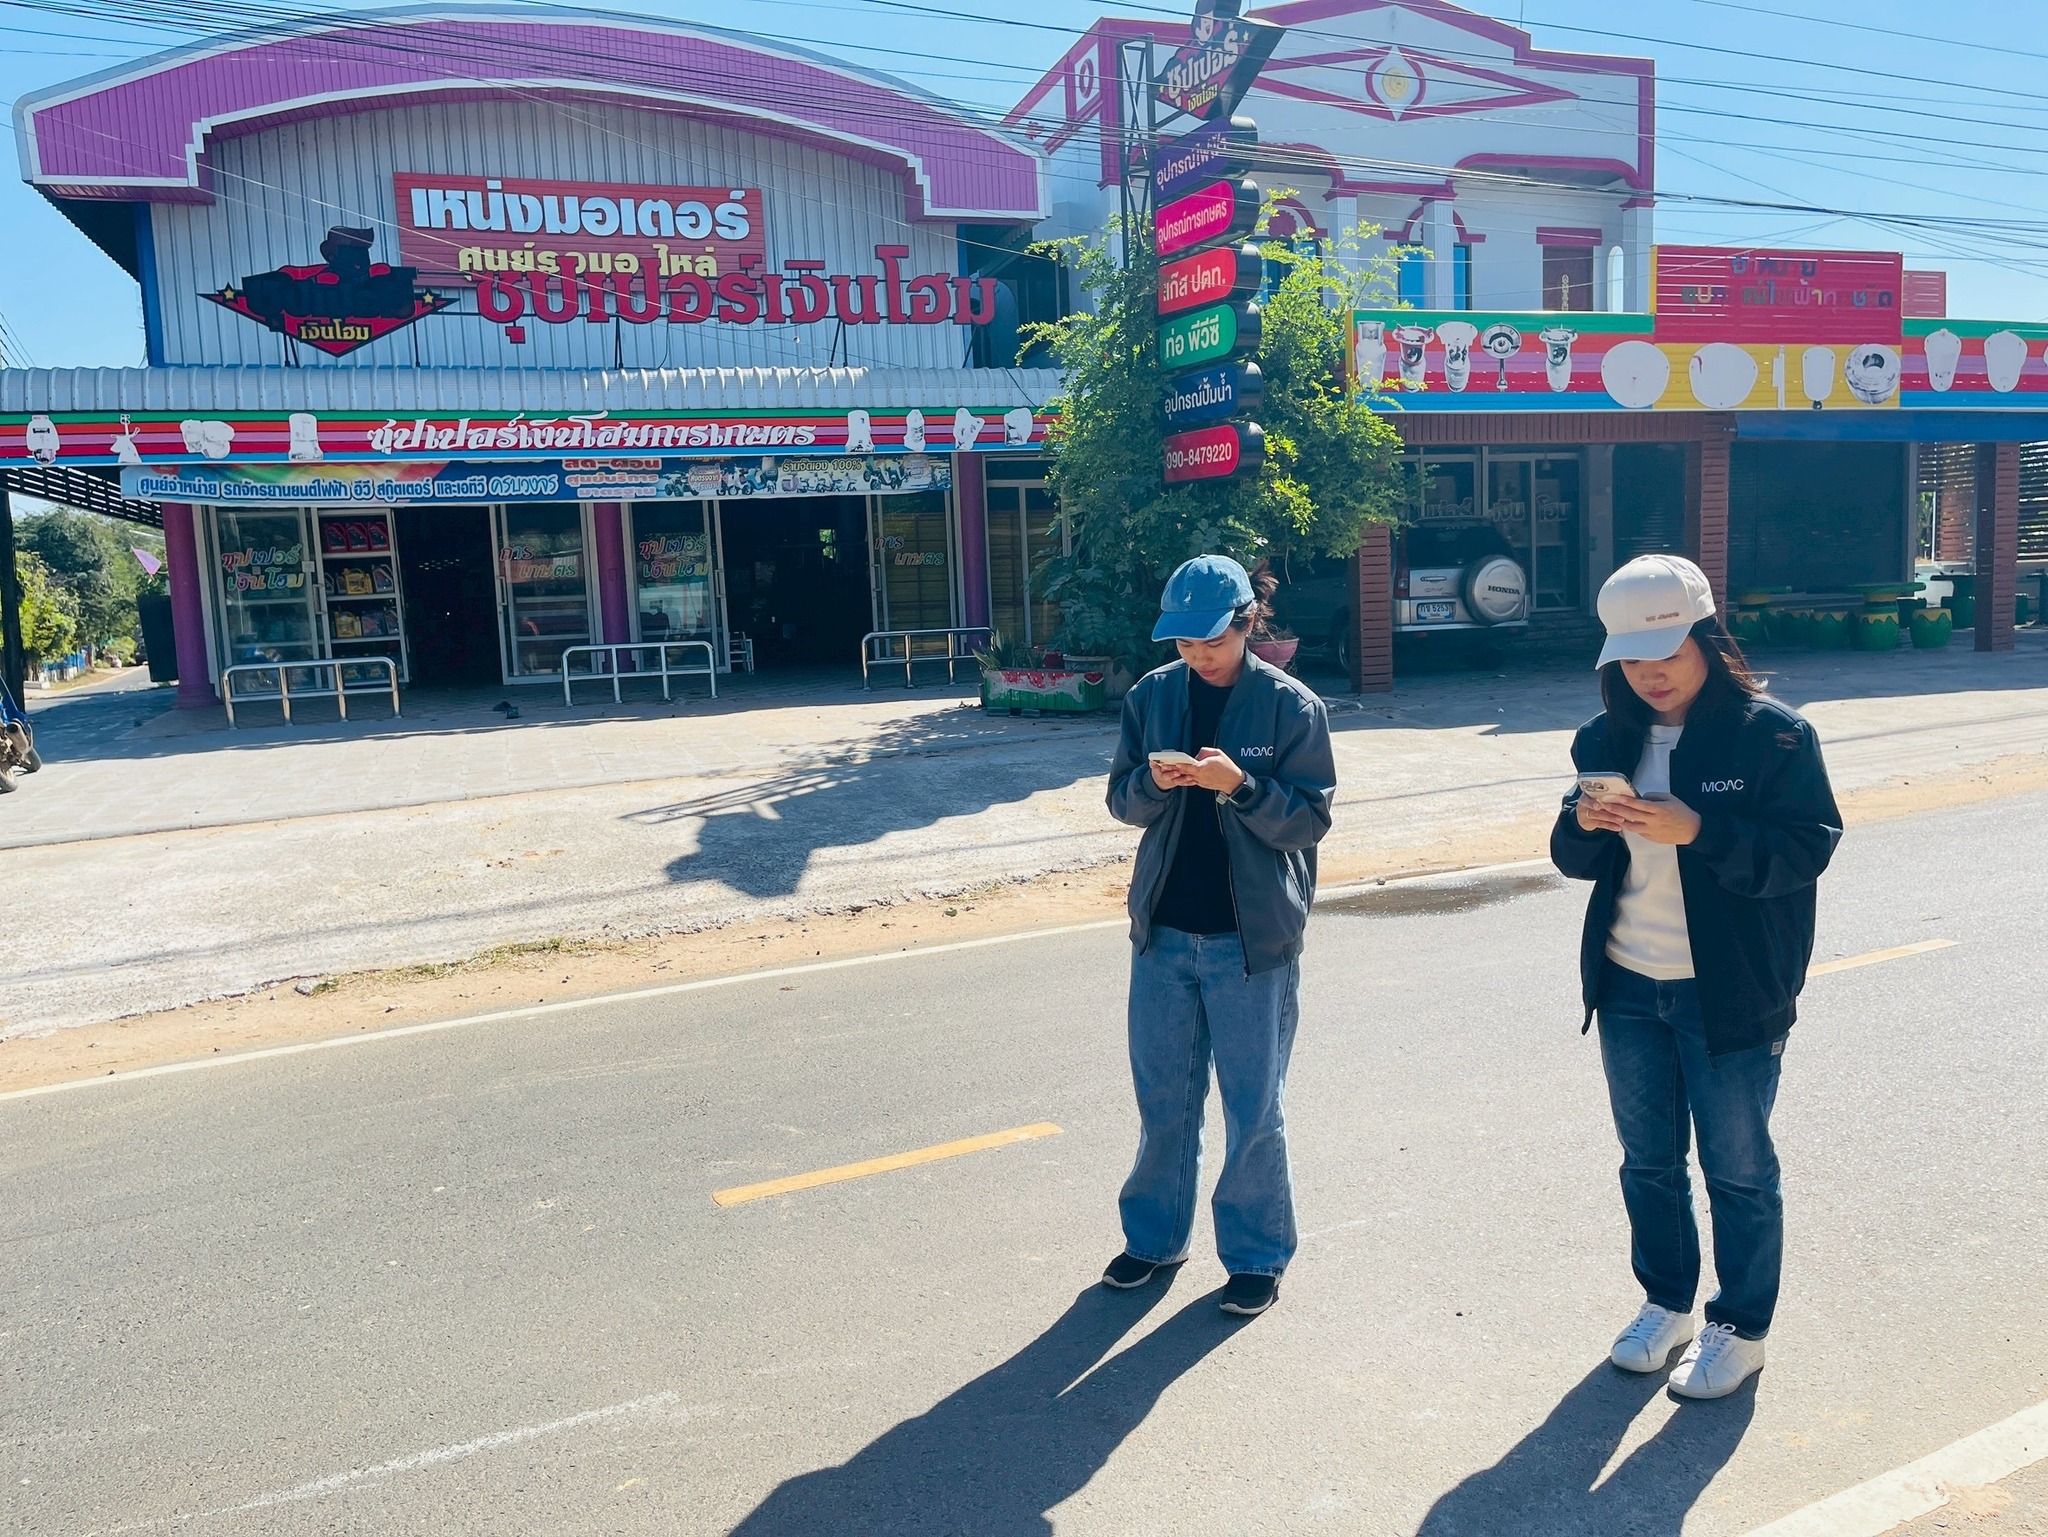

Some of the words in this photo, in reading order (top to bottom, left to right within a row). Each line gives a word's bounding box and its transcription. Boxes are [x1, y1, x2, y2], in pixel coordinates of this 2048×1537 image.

[409, 179, 751, 242] เหน่งมอเตอร์
[1157, 200, 1228, 251] อุปกรณ์การเกษตร
[456, 242, 719, 283] ศูนย์รวมอไหล่
[1190, 264, 1226, 294] ปตท.
[299, 318, 370, 342] เงินโฮม
[1165, 327, 1185, 359] ท่อ
[1187, 313, 1220, 352] พีวีซี
[366, 410, 817, 455] ซุปเปอร์เงินโฮมการเกษตร
[832, 458, 863, 471] 100%
[1166, 441, 1232, 470] 090-8479220
[139, 475, 217, 497] ศูนย์จำหน่าย
[223, 478, 348, 497] รถจักรยานยนต์ไฟฟ้า
[354, 479, 371, 496] อีวี
[377, 478, 431, 500] สกู๊ตเตอร์
[436, 476, 485, 496] และเอทีวี
[490, 476, 557, 494] ครบวงจร
[577, 486, 656, 498] มาตรฐาน
[499, 545, 534, 561] การ
[874, 536, 904, 550] การ
[894, 552, 945, 566] เกษตร
[519, 564, 578, 579] เกษตร
[1487, 584, 1521, 595] HONDA
[1240, 745, 1274, 757] MOAC
[1701, 778, 1744, 793] MOAC
